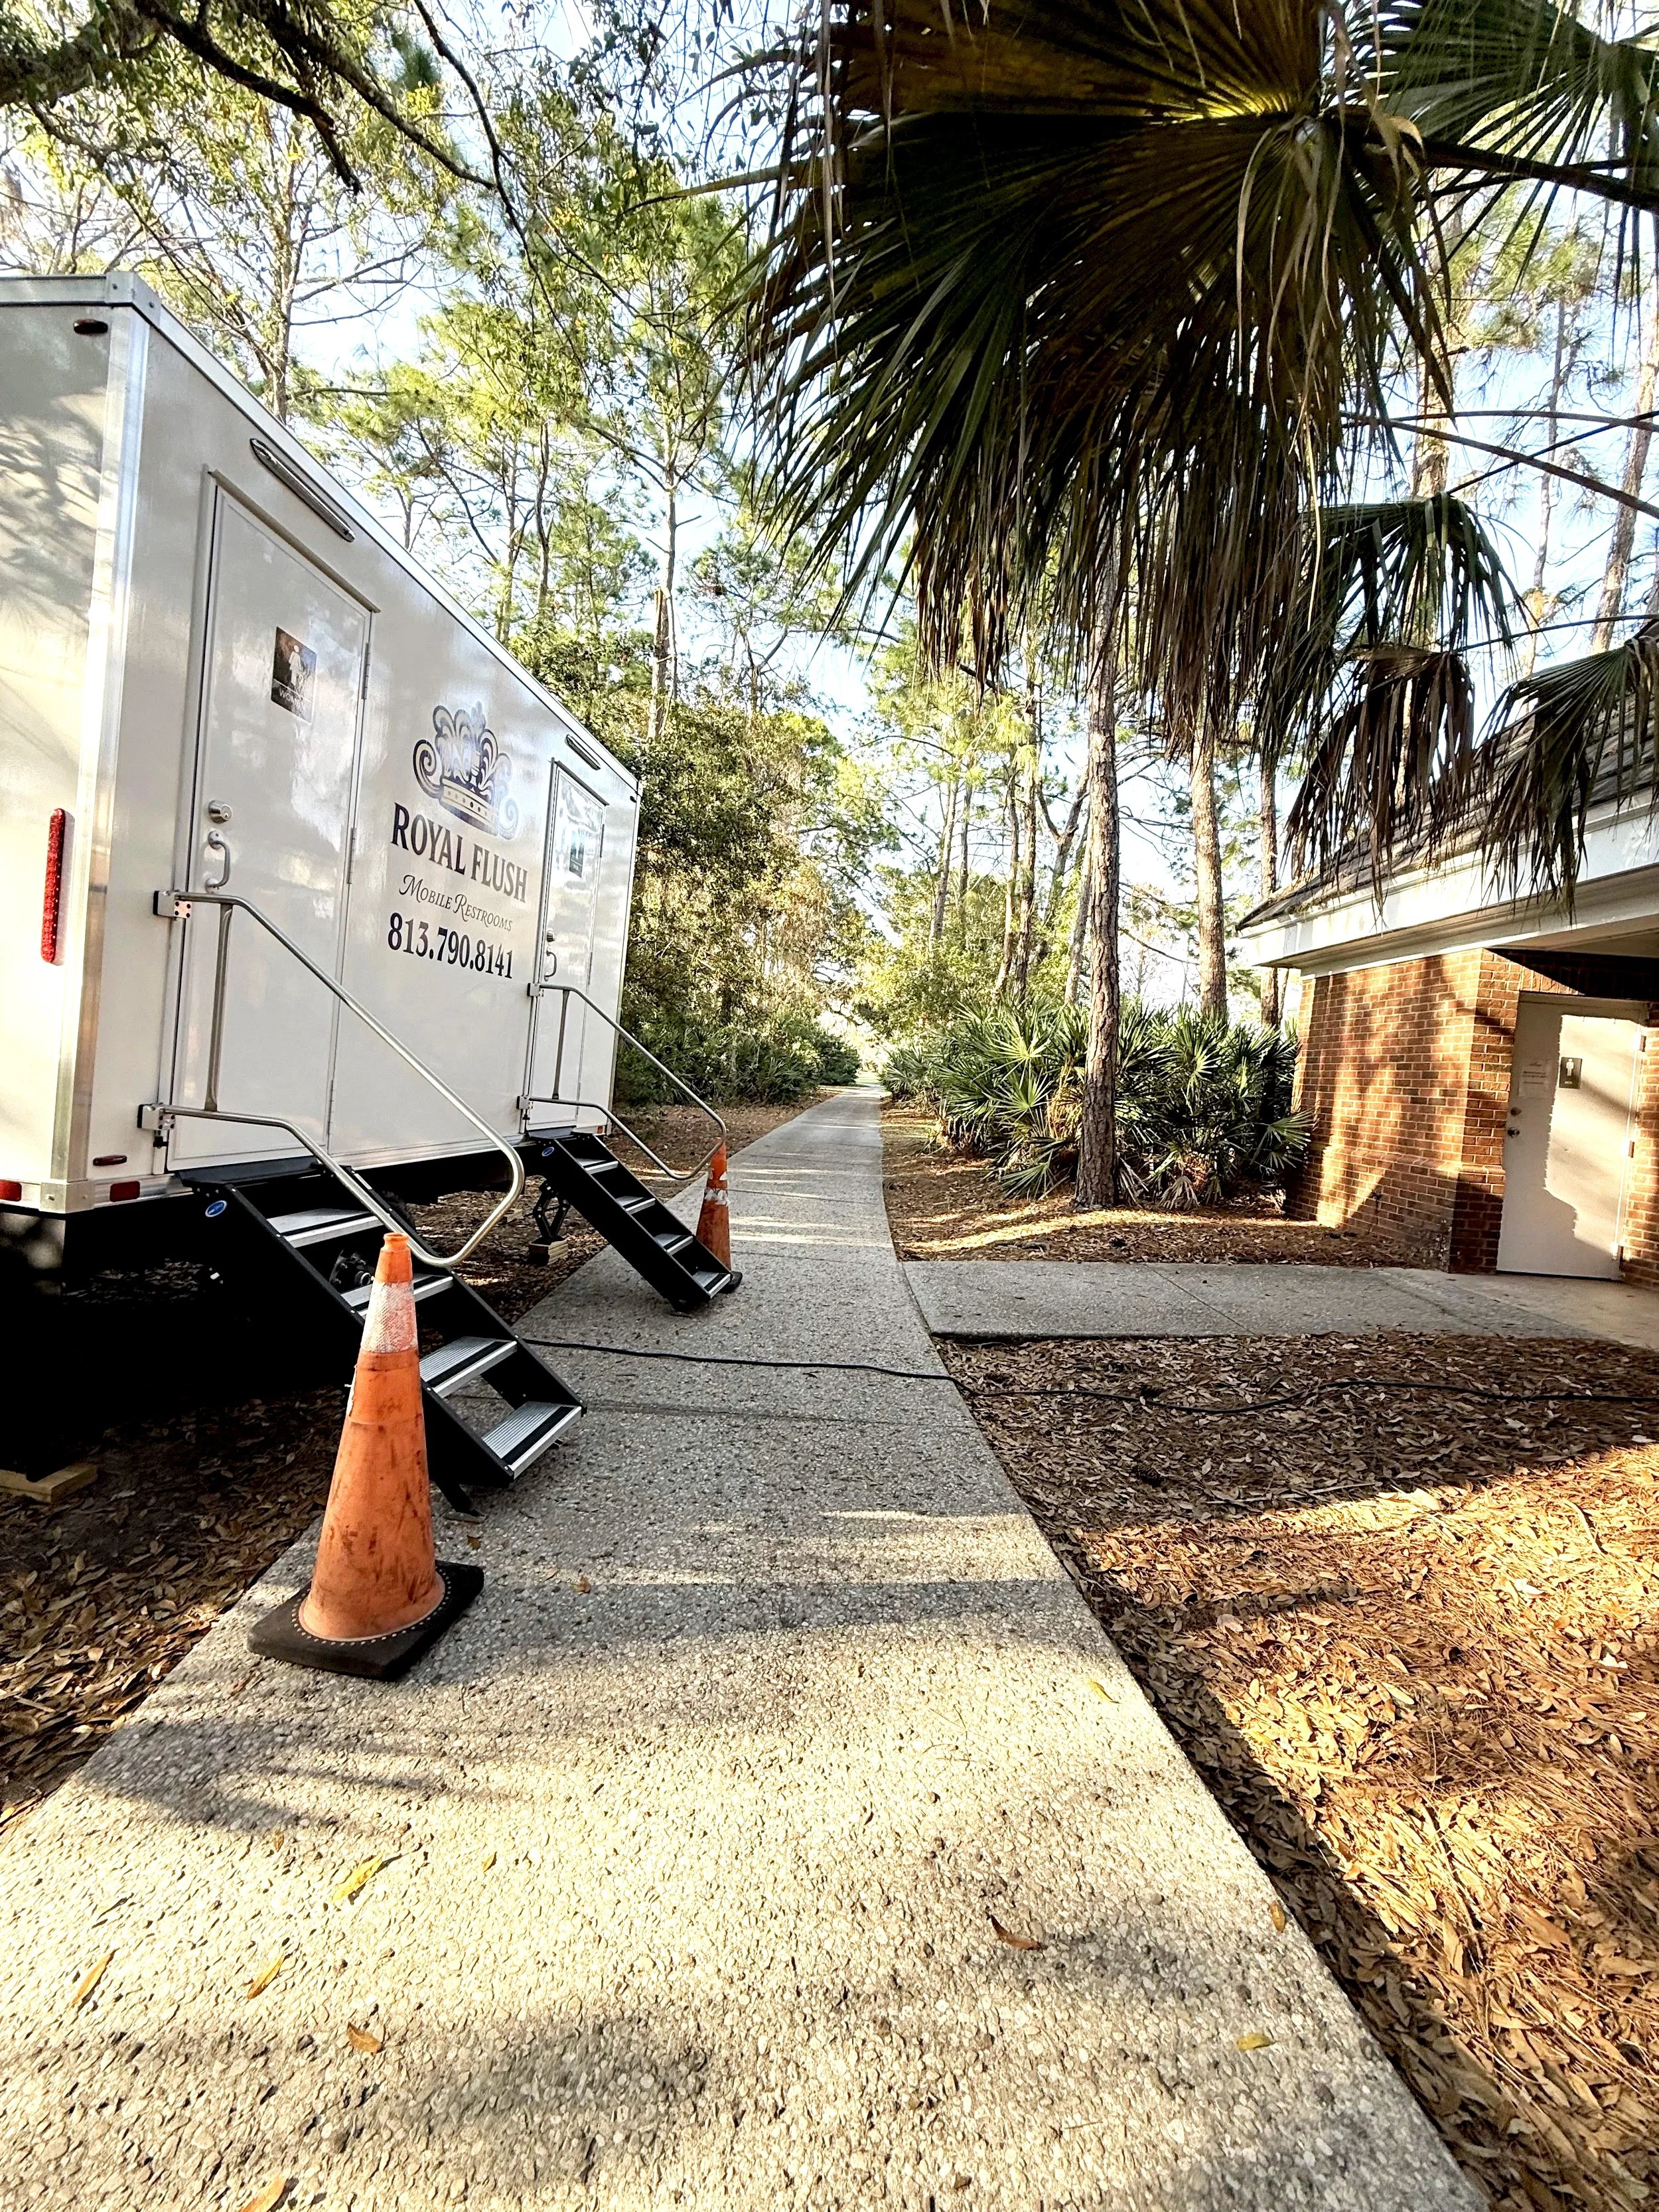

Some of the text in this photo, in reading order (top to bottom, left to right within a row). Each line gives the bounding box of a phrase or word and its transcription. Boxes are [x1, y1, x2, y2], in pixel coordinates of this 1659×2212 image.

[390, 802, 528, 903] ROYAL FLUSH
[399, 875, 512, 931] MOBILE RESTROOMS
[388, 912, 512, 979] 813.790.8141
